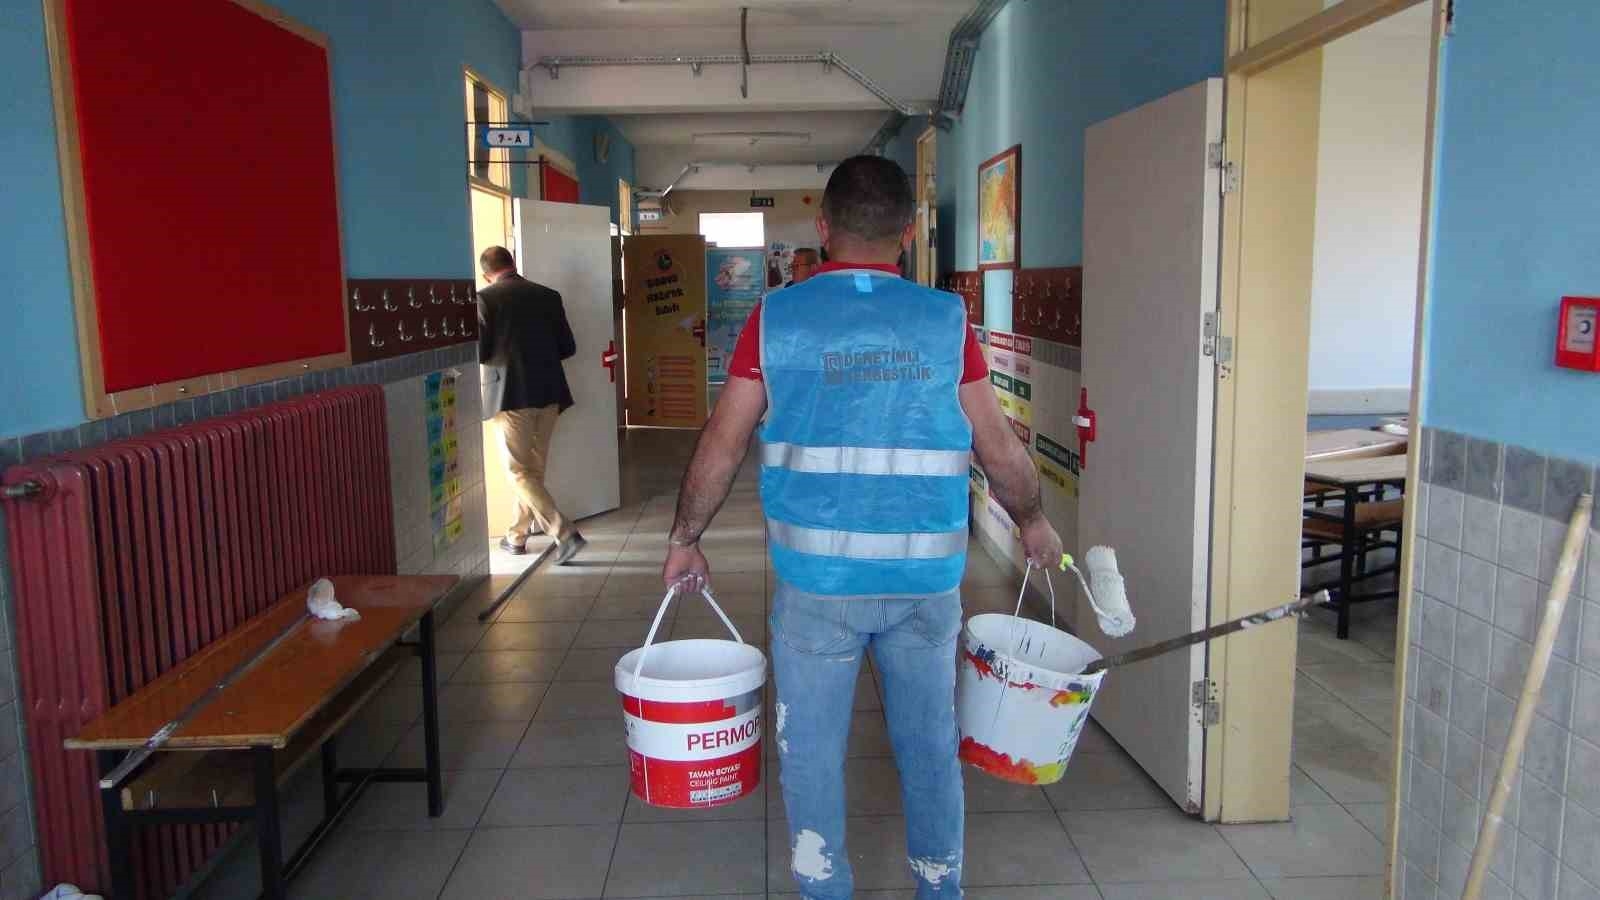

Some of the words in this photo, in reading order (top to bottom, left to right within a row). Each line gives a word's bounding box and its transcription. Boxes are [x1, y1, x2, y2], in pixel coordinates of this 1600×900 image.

[688, 769, 715, 779] TAVAN
[689, 778, 719, 787] CEILING
[720, 773, 738, 785] PAINT
